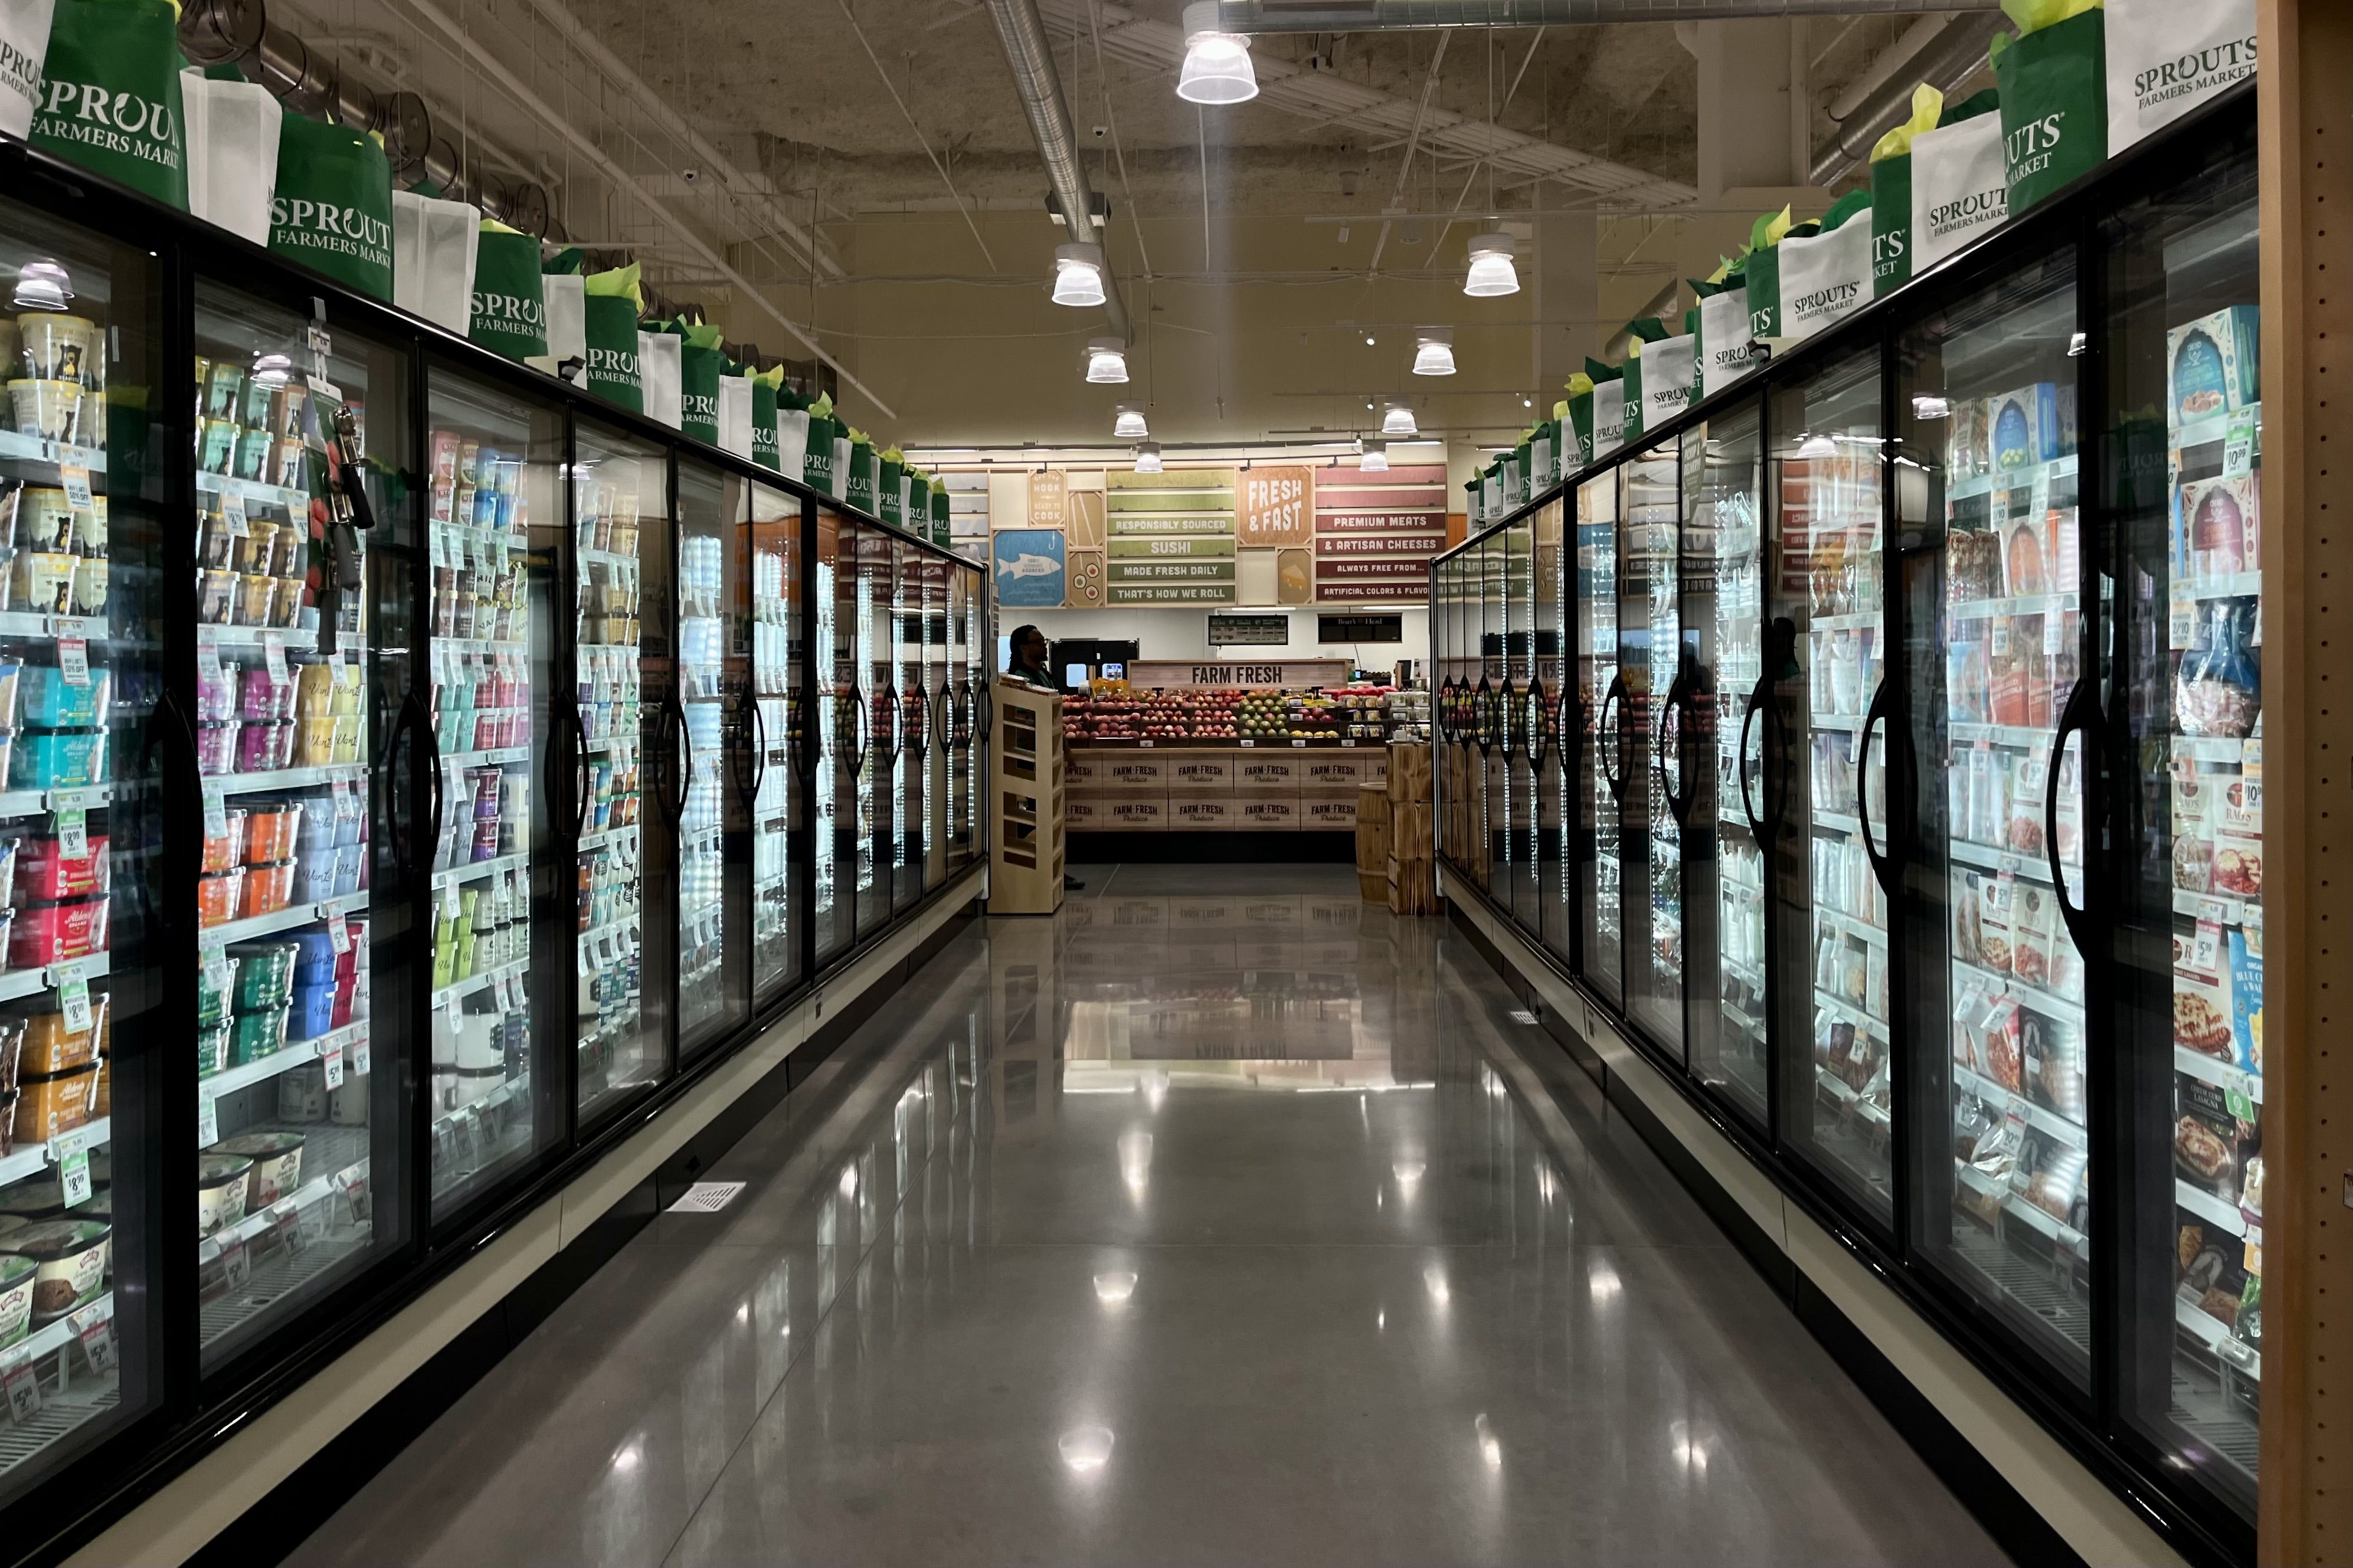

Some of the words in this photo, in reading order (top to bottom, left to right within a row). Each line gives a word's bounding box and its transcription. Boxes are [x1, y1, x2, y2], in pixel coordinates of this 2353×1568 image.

[2135, 35, 2257, 97] SPROUTS
[2139, 81, 2192, 109] FARMERS
[2195, 63, 2255, 91] MARKET
[1934, 217, 1973, 237] FARMERS
[277, 230, 357, 256] FARMERS
[1795, 281, 1858, 315] SPROUTS
[1797, 306, 1822, 323] FARMERS
[1824, 299, 1854, 314] MARKET
[476, 318, 534, 337] FARMERS
[1034, 483, 1061, 492] HOOK
[1248, 480, 1302, 512] FRESH
[1034, 512, 1061, 520] COOK
[1249, 515, 1259, 532] &
[1262, 500, 1302, 531] FAST
[1334, 516, 1385, 528] PREMIUM
[1389, 516, 1426, 526] MEATS
[1116, 521, 1179, 530] RESPONSIBLY
[1182, 520, 1226, 529] SOURCED
[1151, 541, 1191, 554] SUSHI
[1324, 541, 1332, 551] &
[1336, 540, 1383, 550] ARTISAN
[1387, 539, 1436, 549] CHEESES
[1124, 567, 1152, 576] MADE
[1155, 566, 1187, 575] FRESH
[1190, 565, 1218, 575] DAILY
[1337, 564, 1369, 572] ALWAYS
[1117, 590, 1153, 599] THAT'S
[1156, 589, 1178, 598] HOW
[1182, 589, 1197, 598] WE
[1200, 588, 1225, 598] ROLL
[1324, 587, 1364, 595] ARTIFICIAL
[1366, 587, 1395, 595] COLORS
[1192, 666, 1231, 684] FARM
[1236, 666, 1282, 683] FRESH
